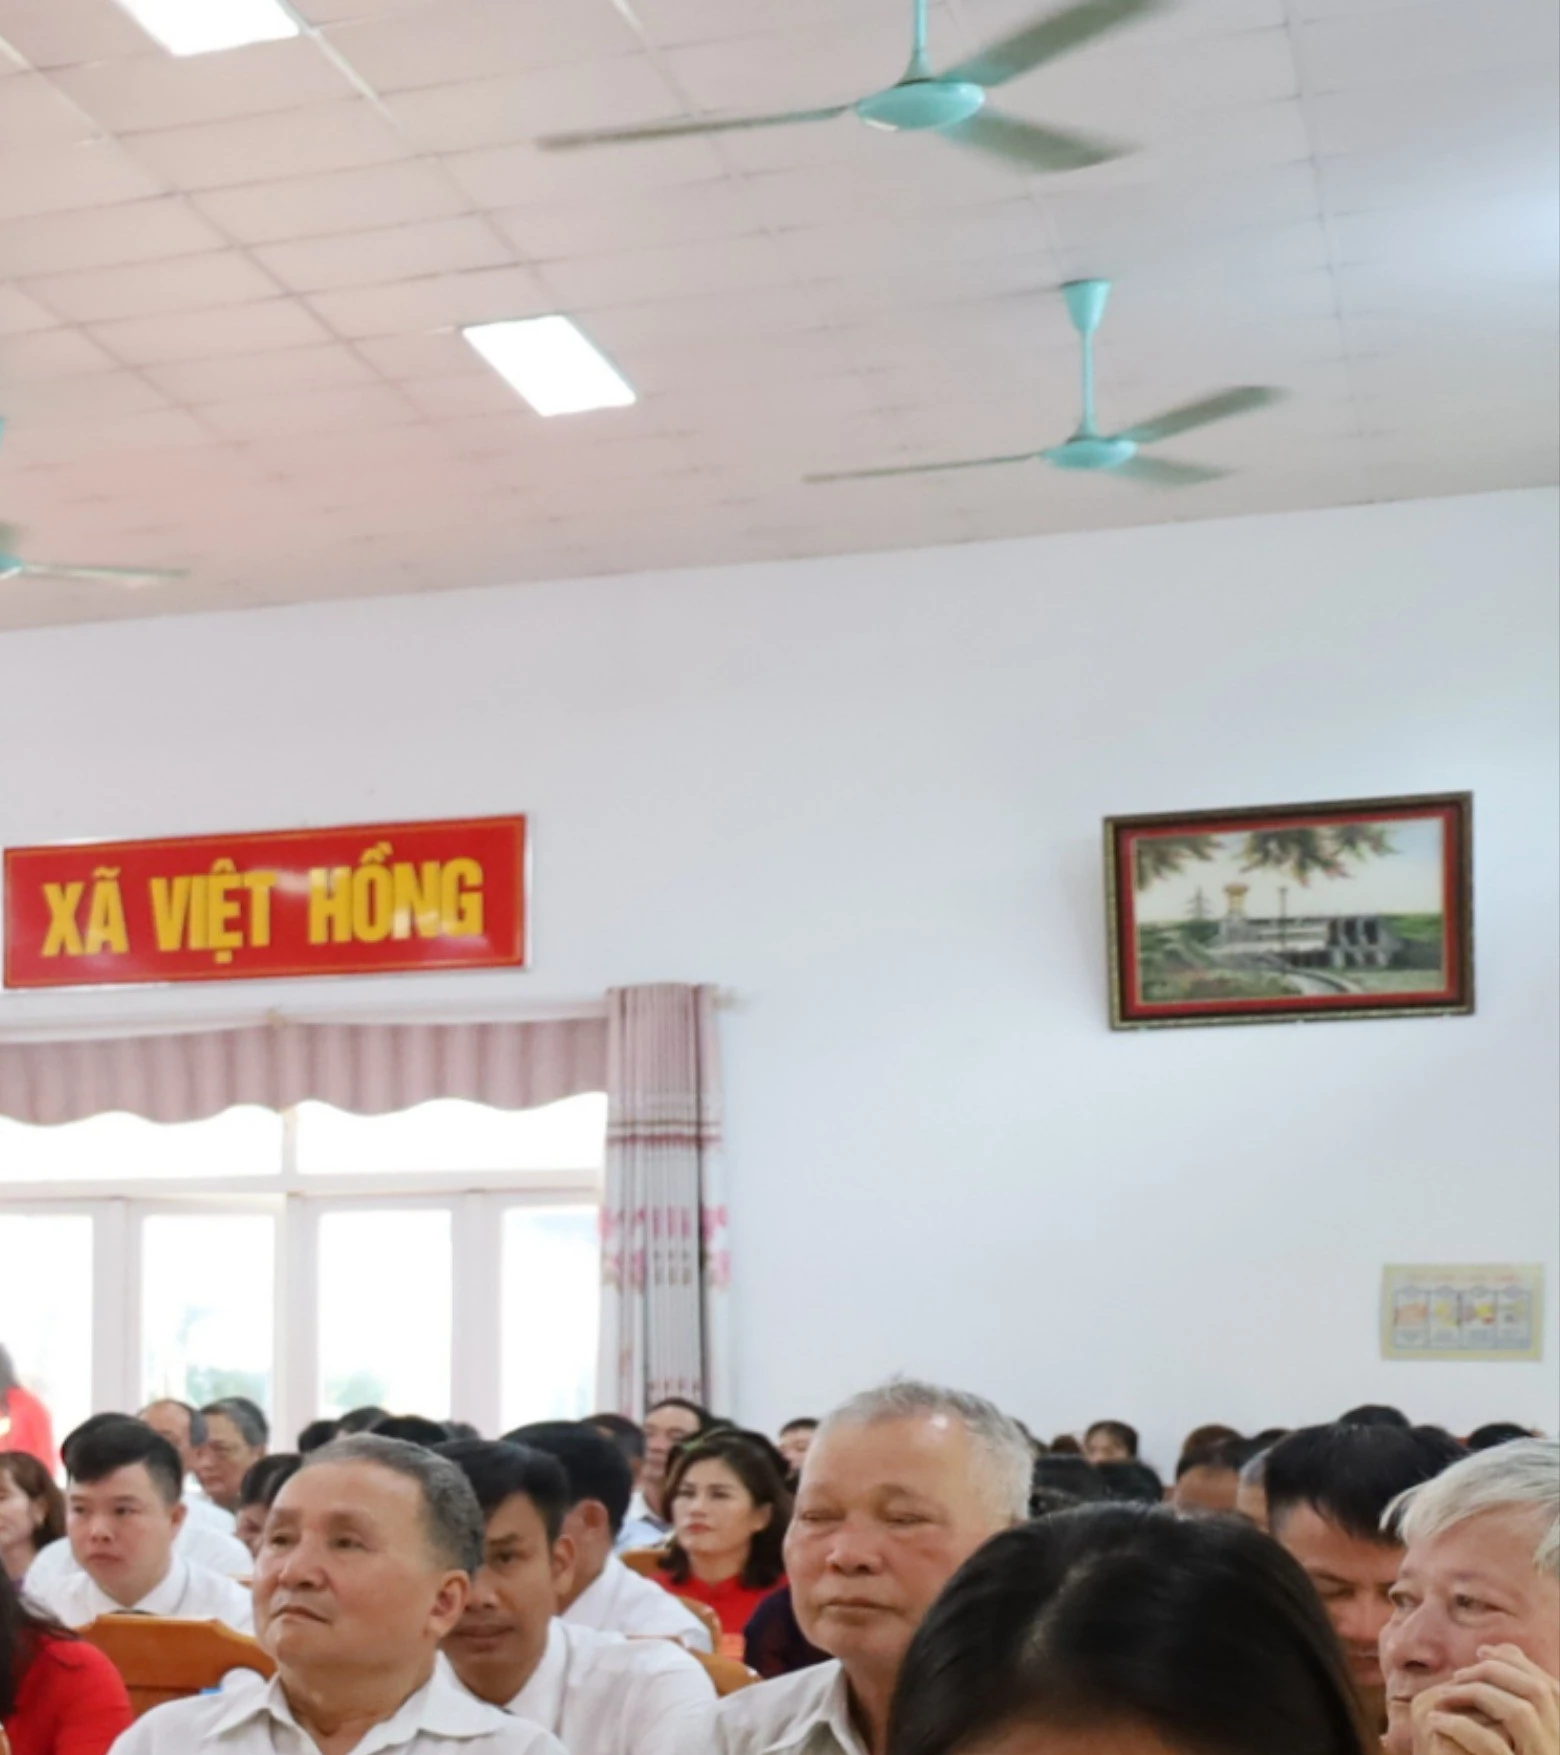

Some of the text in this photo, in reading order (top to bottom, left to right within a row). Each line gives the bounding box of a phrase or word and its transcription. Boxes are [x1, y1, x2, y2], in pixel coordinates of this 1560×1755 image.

[41, 841, 484, 964] XÃ VIỆT HỒNG
